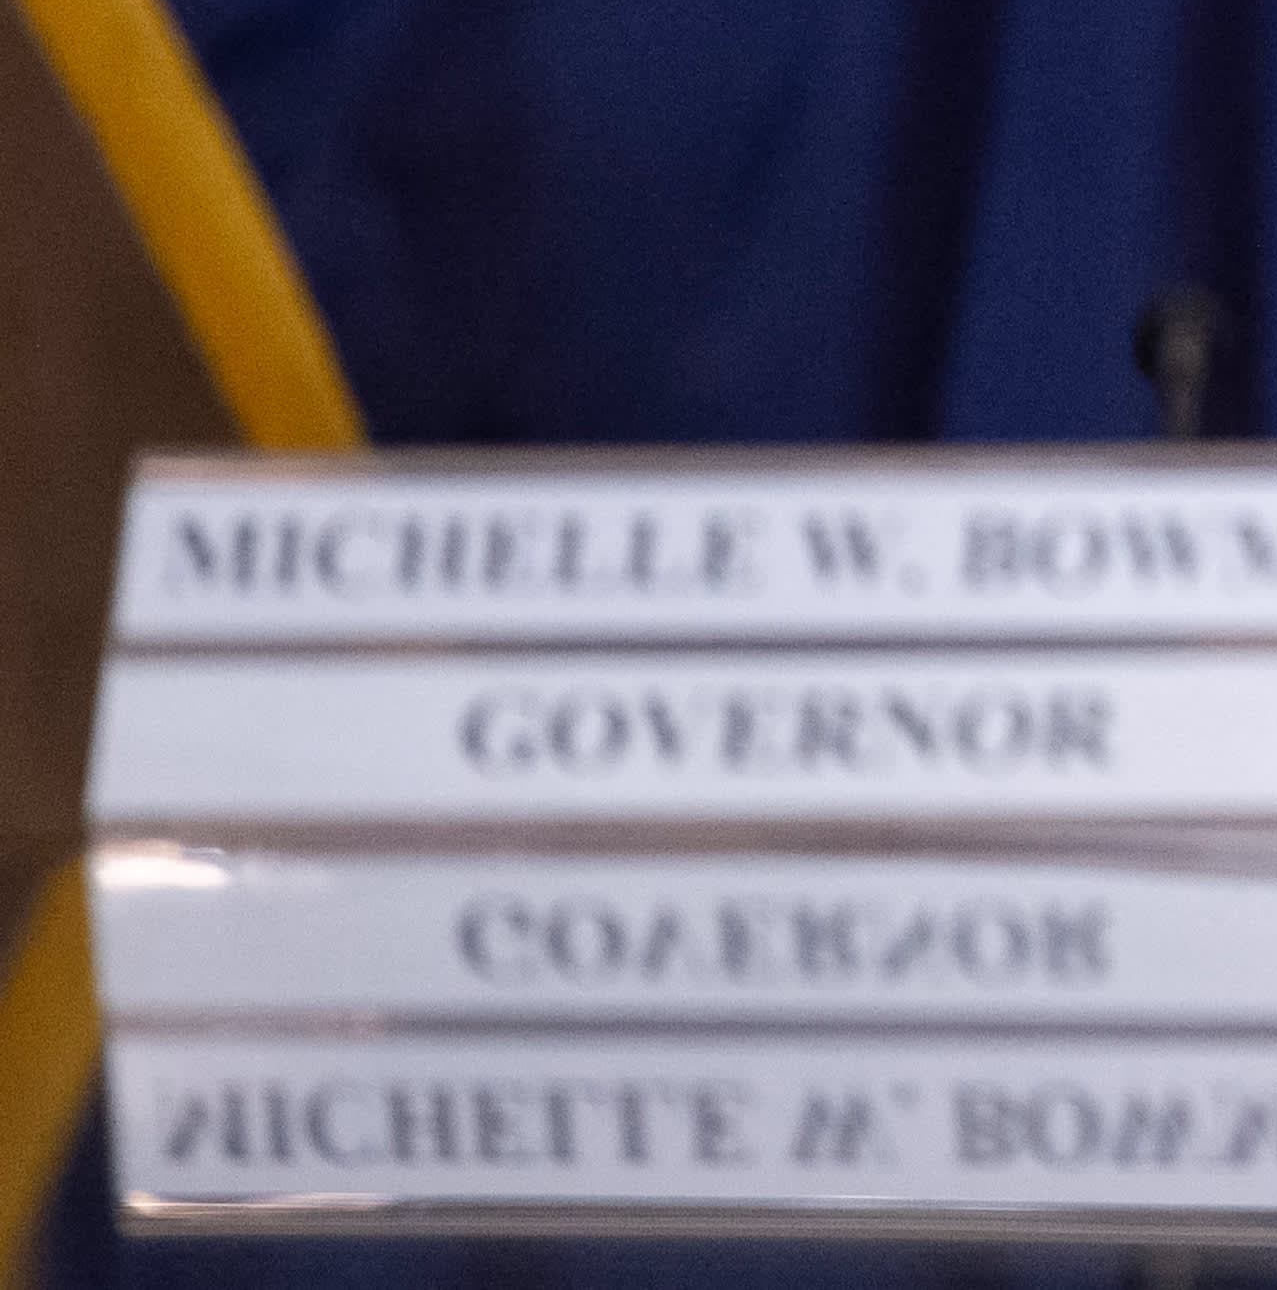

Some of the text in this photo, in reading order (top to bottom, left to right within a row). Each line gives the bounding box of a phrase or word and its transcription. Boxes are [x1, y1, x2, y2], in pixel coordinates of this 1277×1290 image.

[163, 506, 762, 599] MICHELLE
[791, 508, 926, 599] W.
[456, 688, 1116, 778] GOVERNOR
